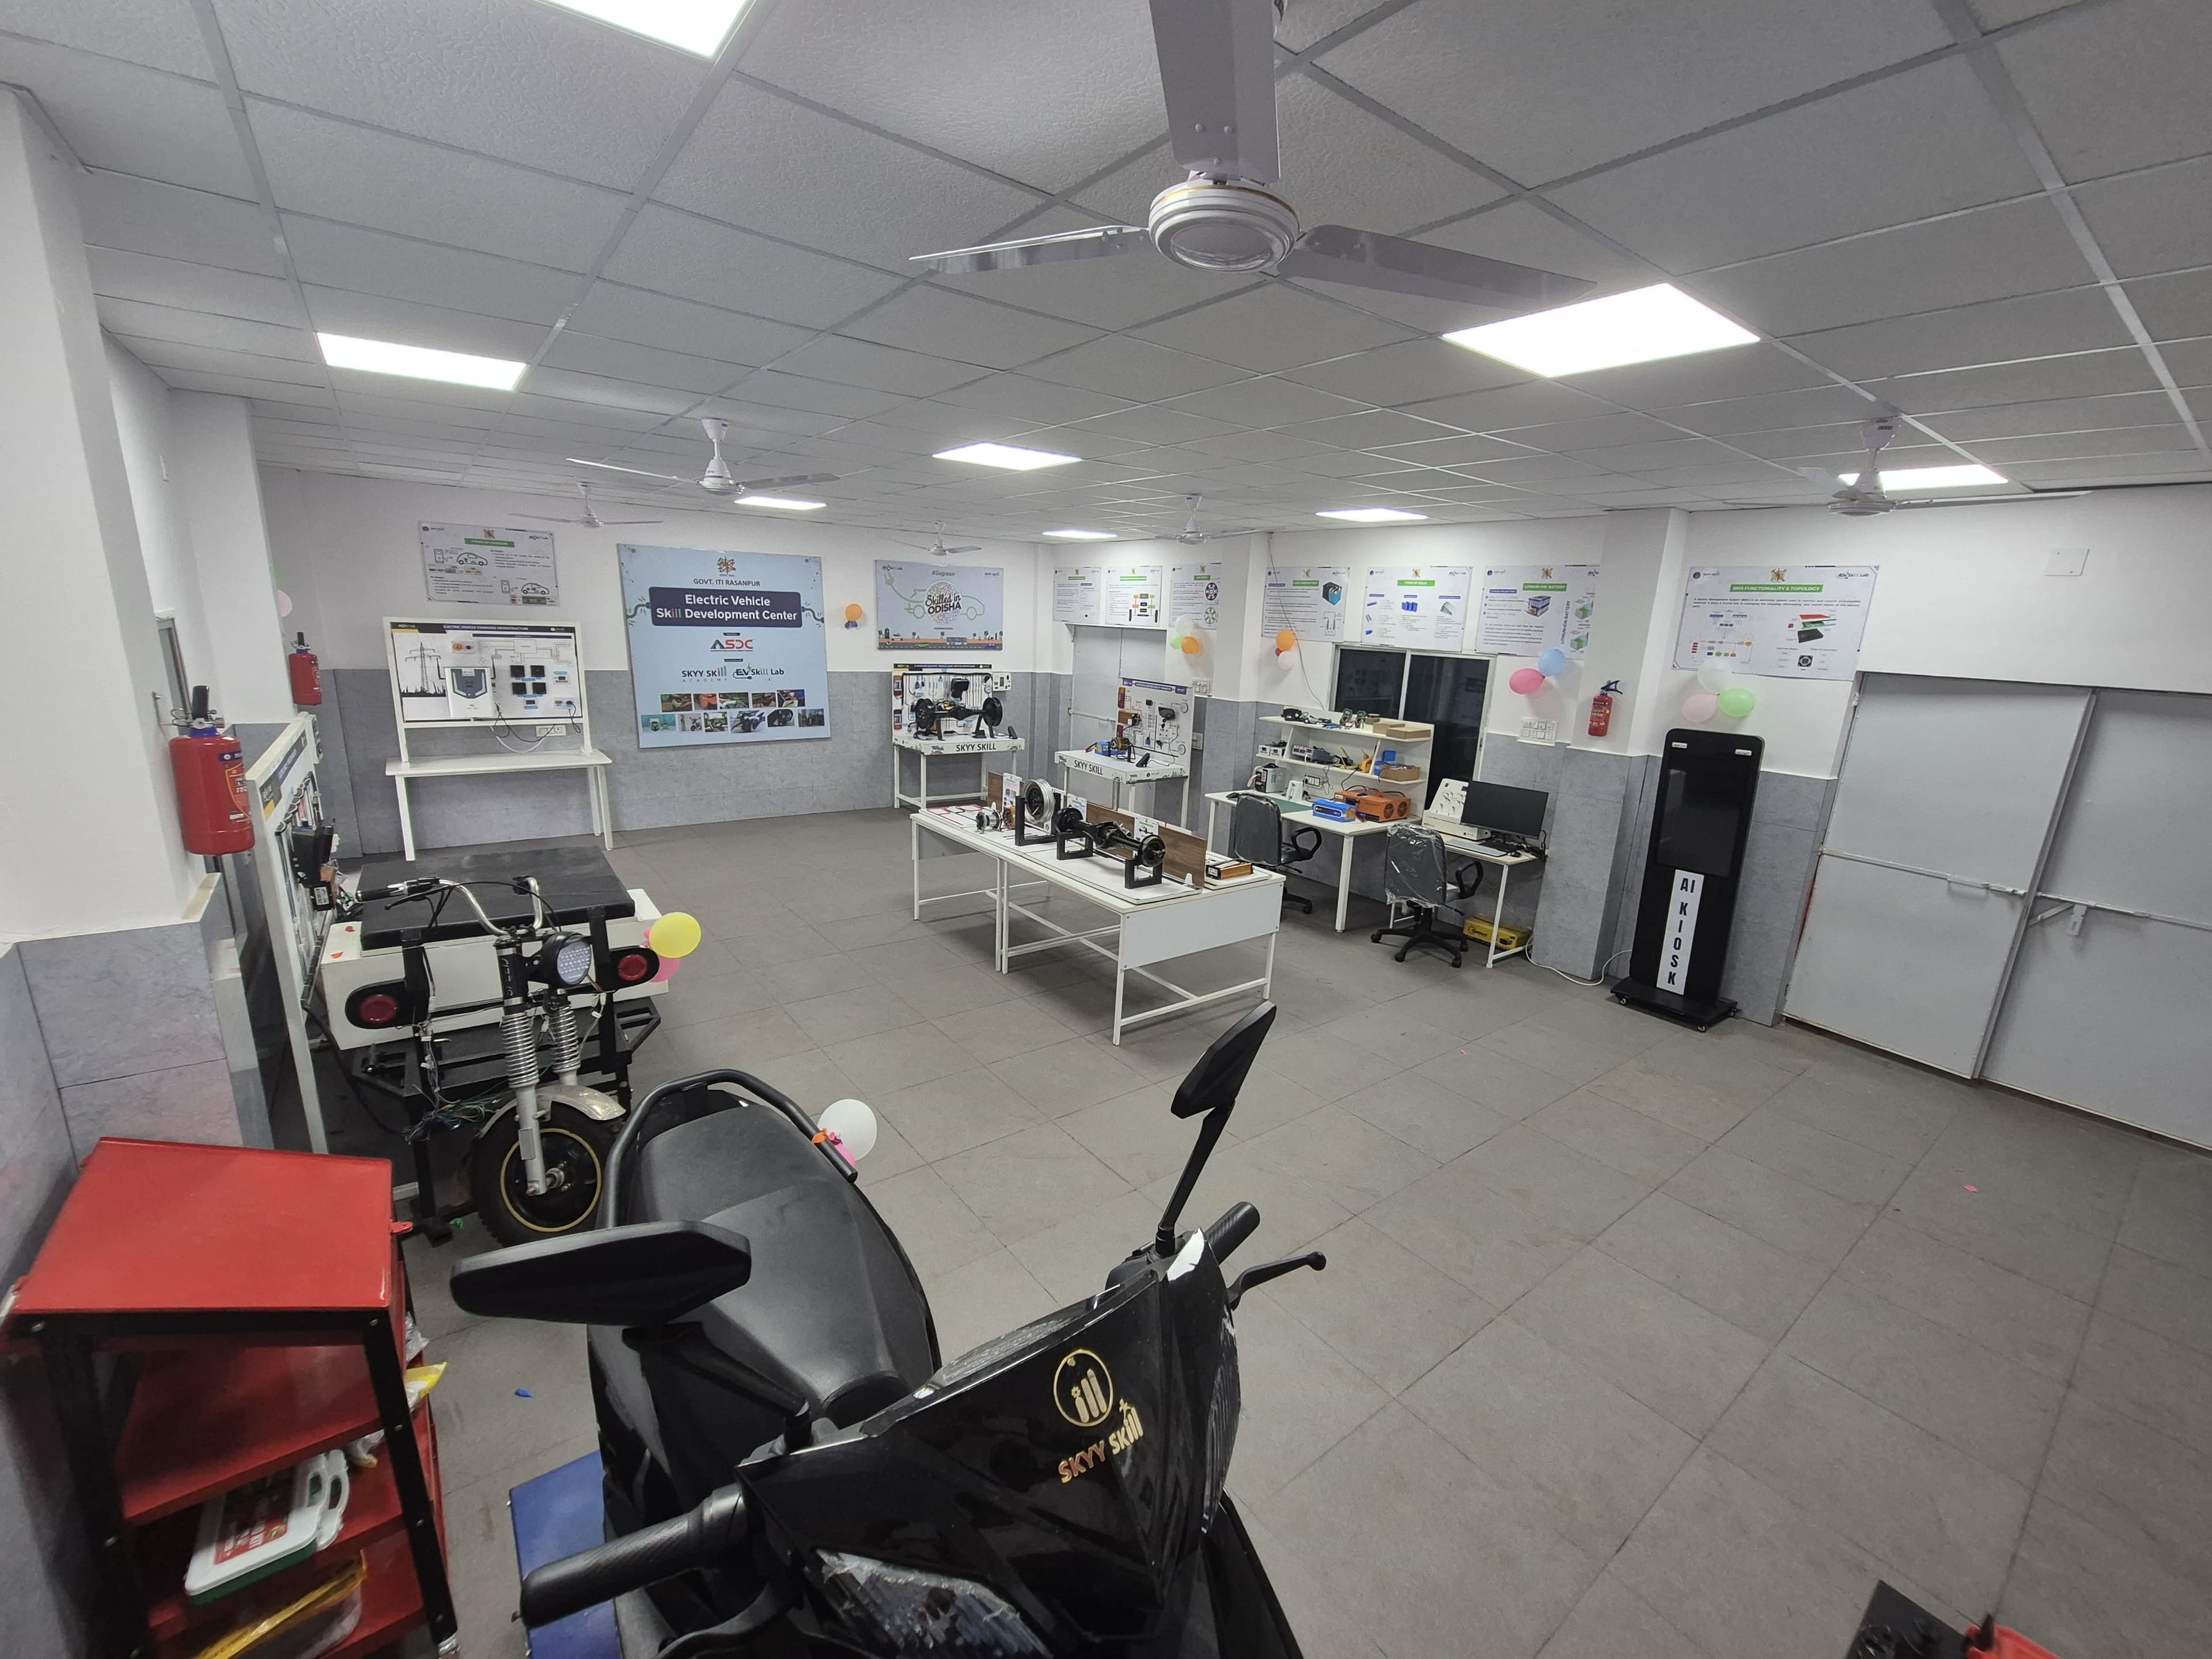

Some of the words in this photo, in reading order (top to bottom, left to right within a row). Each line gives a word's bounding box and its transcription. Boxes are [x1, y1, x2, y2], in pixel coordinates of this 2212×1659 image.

[685, 594, 729, 605] Electric
[730, 596, 770, 606] Vehicle
[925, 593, 953, 607] Skilled
[954, 593, 961, 602] in
[656, 608, 681, 618] Skill
[684, 608, 759, 621] Development
[762, 610, 797, 620] Center
[927, 601, 961, 615] ODISHA
[710, 639, 753, 650] ASDC
[736, 668, 749, 676] EV
[956, 744, 975, 752] SKYY
[978, 743, 997, 751] SKILL
[1074, 760, 1088, 770] SKYY
[1089, 764, 1103, 775] SKILL
[1680, 878, 1695, 893] AI
[1668, 902, 1688, 985] KIOSK
[1058, 1440, 1105, 1483] SKYY
